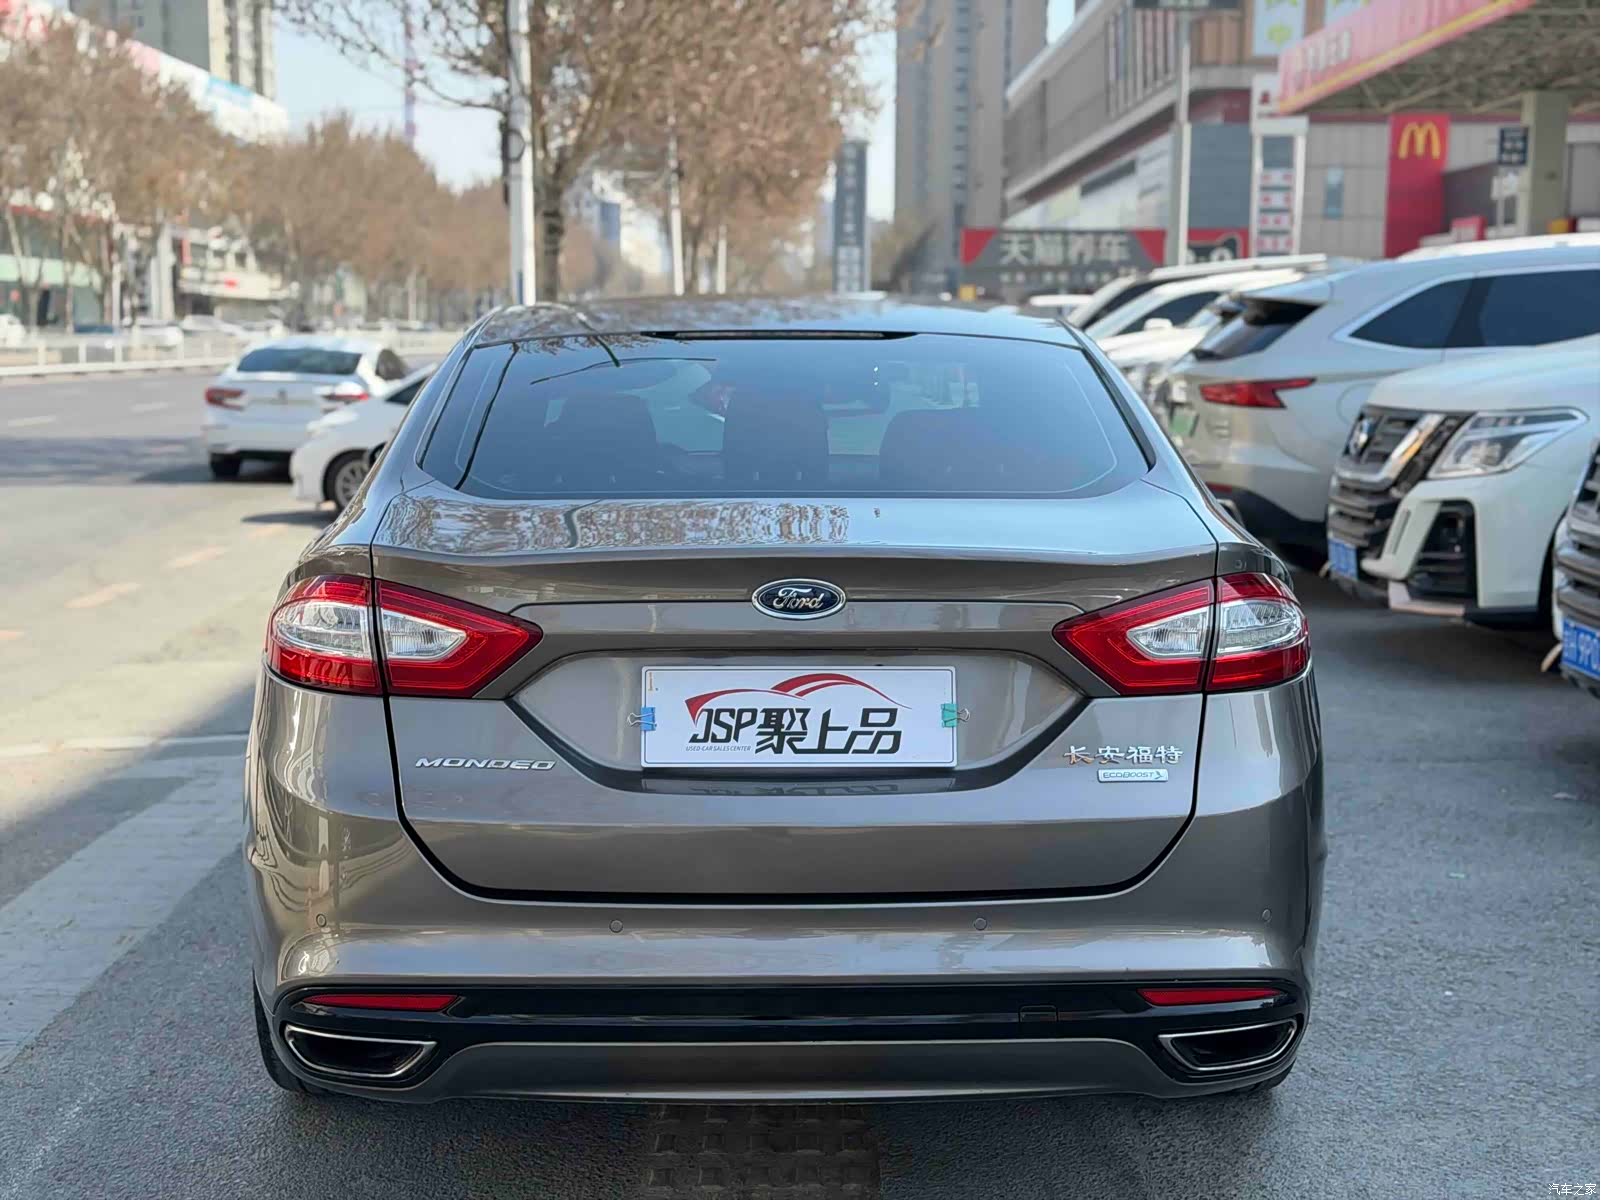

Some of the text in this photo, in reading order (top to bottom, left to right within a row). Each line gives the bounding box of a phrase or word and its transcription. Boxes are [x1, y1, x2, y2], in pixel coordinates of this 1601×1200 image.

[773, 587, 825, 609] Ford
[1064, 745, 1184, 764] 长安福特
[415, 757, 556, 771] MONDEO
[1102, 771, 1154, 779] ECOBOOST
